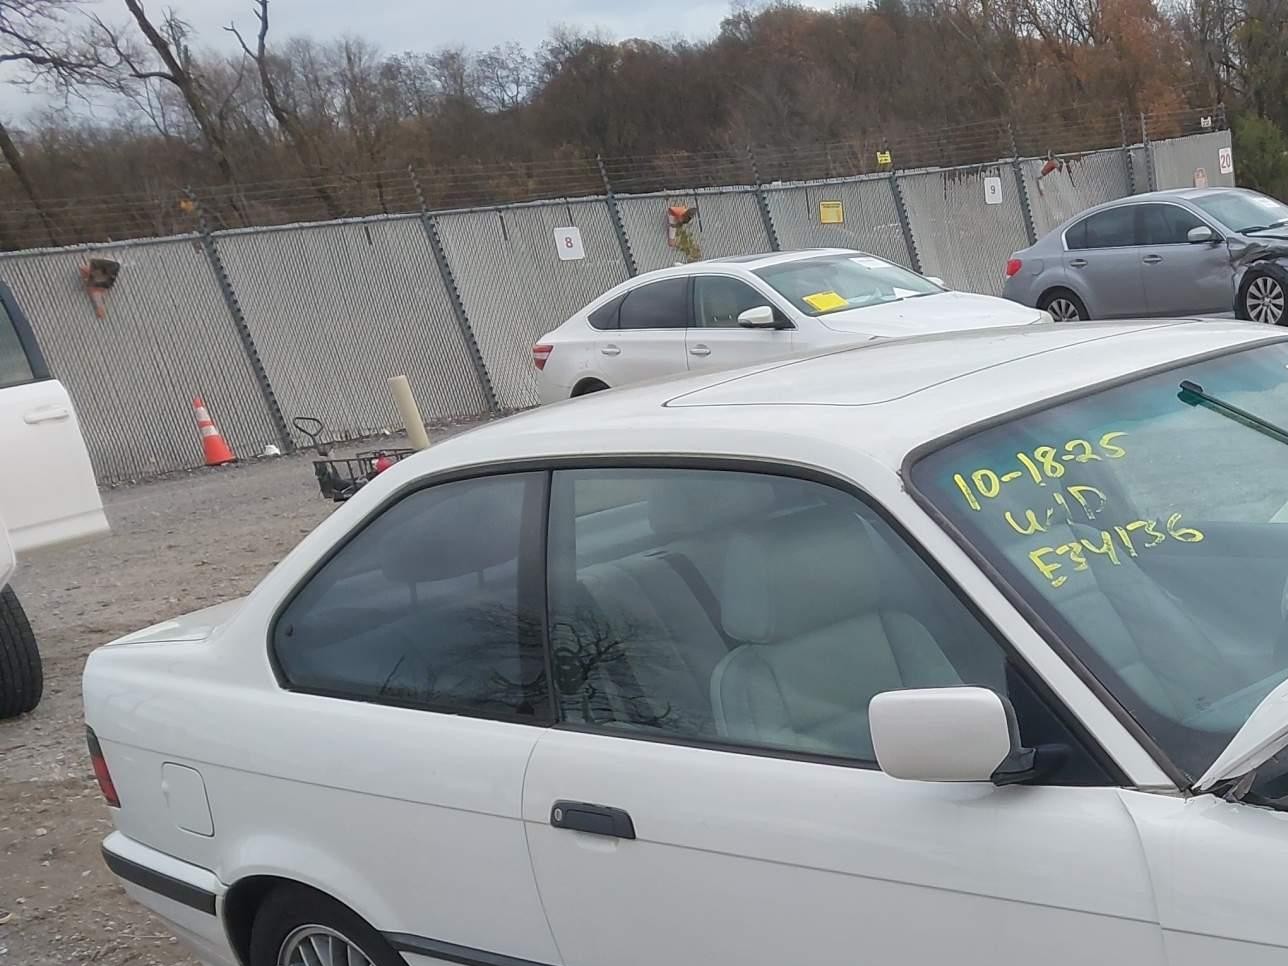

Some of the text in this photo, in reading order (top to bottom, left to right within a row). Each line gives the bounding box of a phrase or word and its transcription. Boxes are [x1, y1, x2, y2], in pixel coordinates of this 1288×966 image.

[1221, 153, 1231, 169] 20
[990, 185, 996, 195] 9
[564, 236, 573, 248] 8
[954, 432, 1128, 510] 10-18-25
